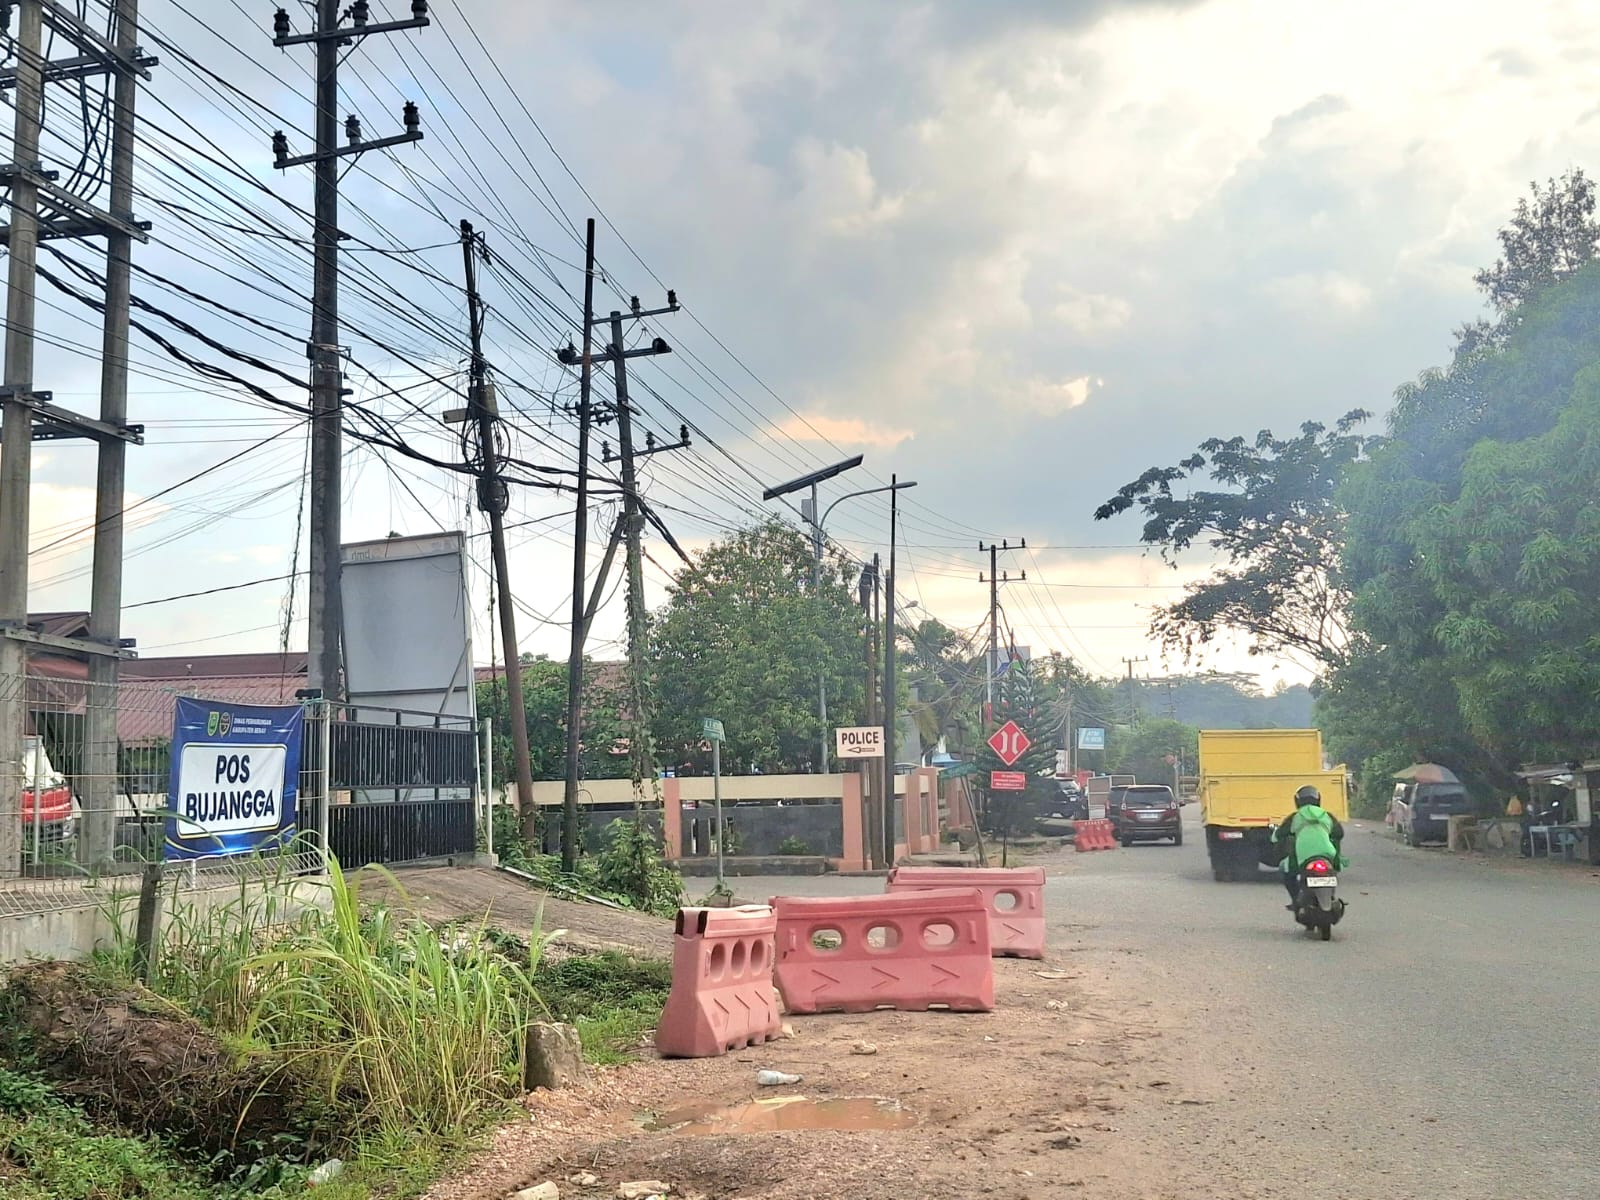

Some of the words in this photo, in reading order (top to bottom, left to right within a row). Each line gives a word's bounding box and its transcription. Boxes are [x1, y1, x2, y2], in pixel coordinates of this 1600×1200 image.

[841, 731, 879, 745] POLICE
[215, 754, 250, 784] POS
[185, 789, 275, 822] BUJANGGA
